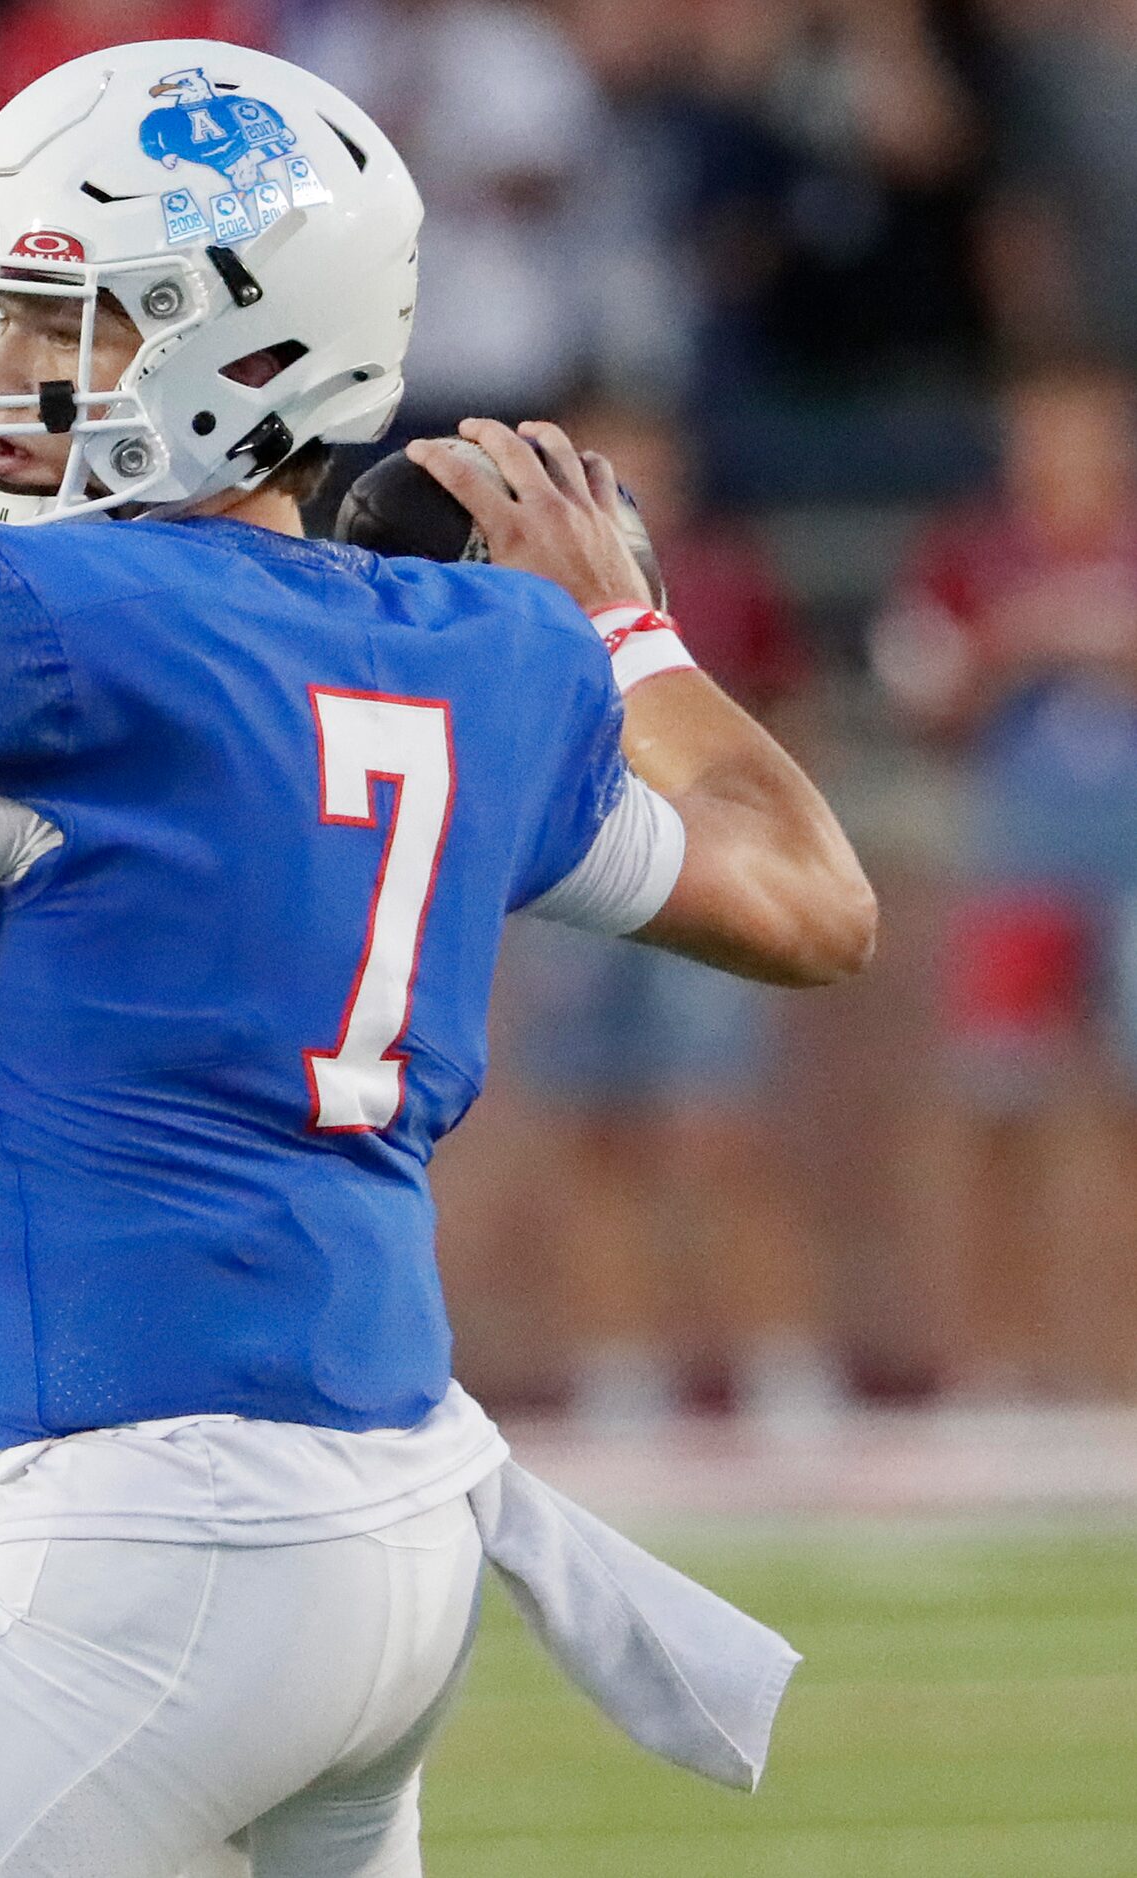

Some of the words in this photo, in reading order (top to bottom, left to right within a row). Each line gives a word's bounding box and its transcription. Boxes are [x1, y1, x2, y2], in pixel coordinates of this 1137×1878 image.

[188, 109, 227, 144] A
[245, 120, 277, 140] 2017
[168, 212, 203, 235] 2008
[261, 204, 289, 226] 201
[217, 216, 250, 239] 2012
[302, 683, 457, 1134] 7
